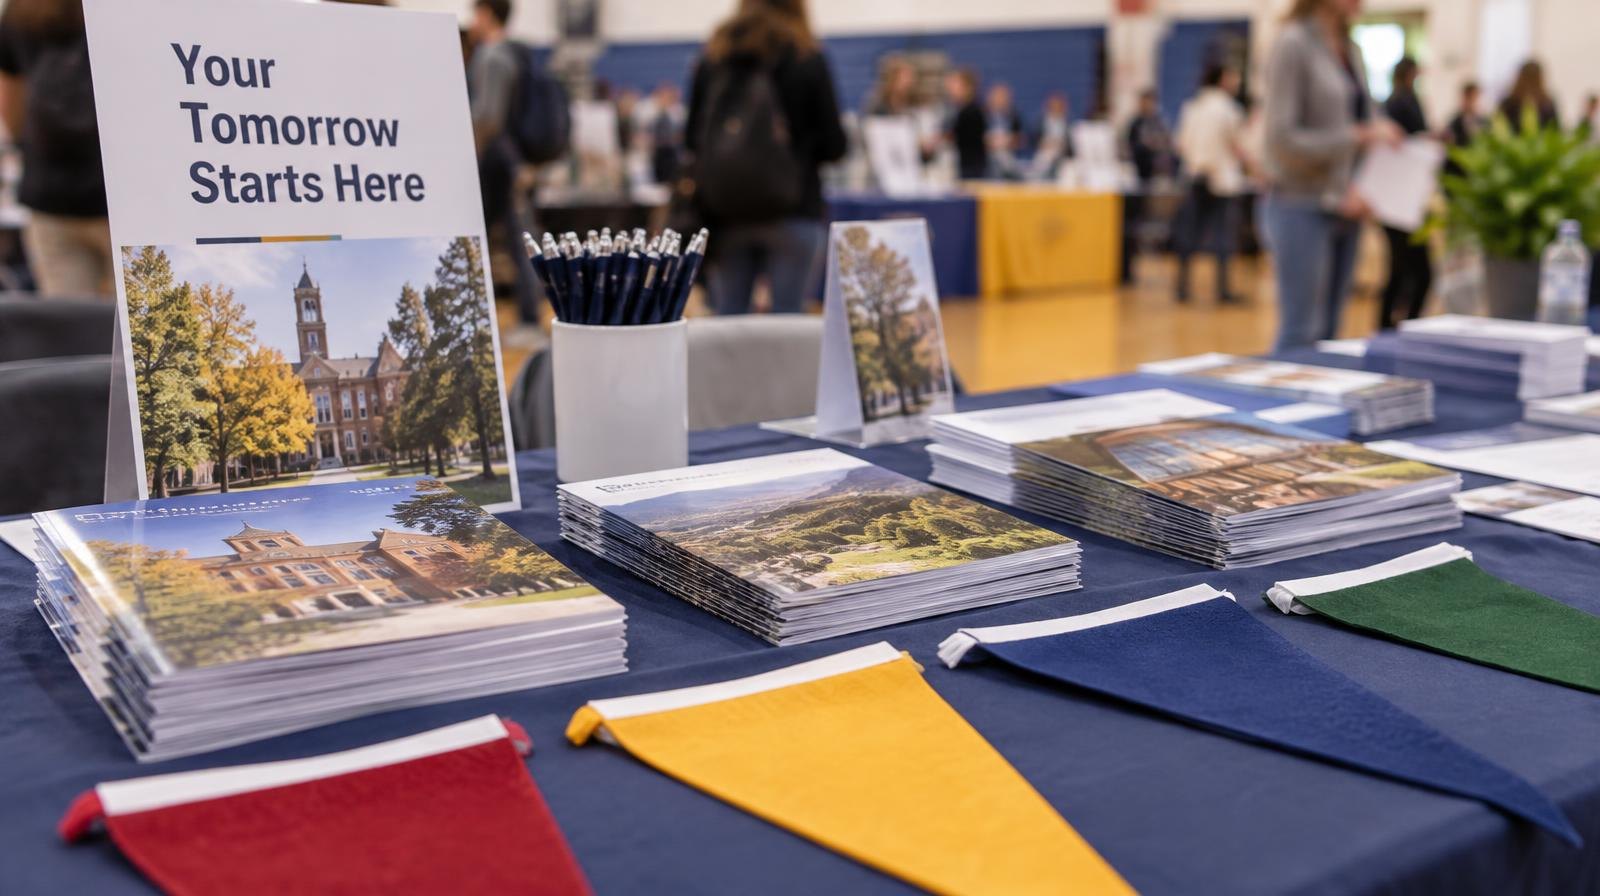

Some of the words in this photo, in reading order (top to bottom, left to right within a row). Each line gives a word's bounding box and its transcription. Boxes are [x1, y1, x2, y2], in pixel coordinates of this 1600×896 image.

[171, 42, 276, 89] Your
[180, 101, 399, 148] Tomorrow
[190, 160, 324, 205] Starts
[333, 163, 425, 204] Here
